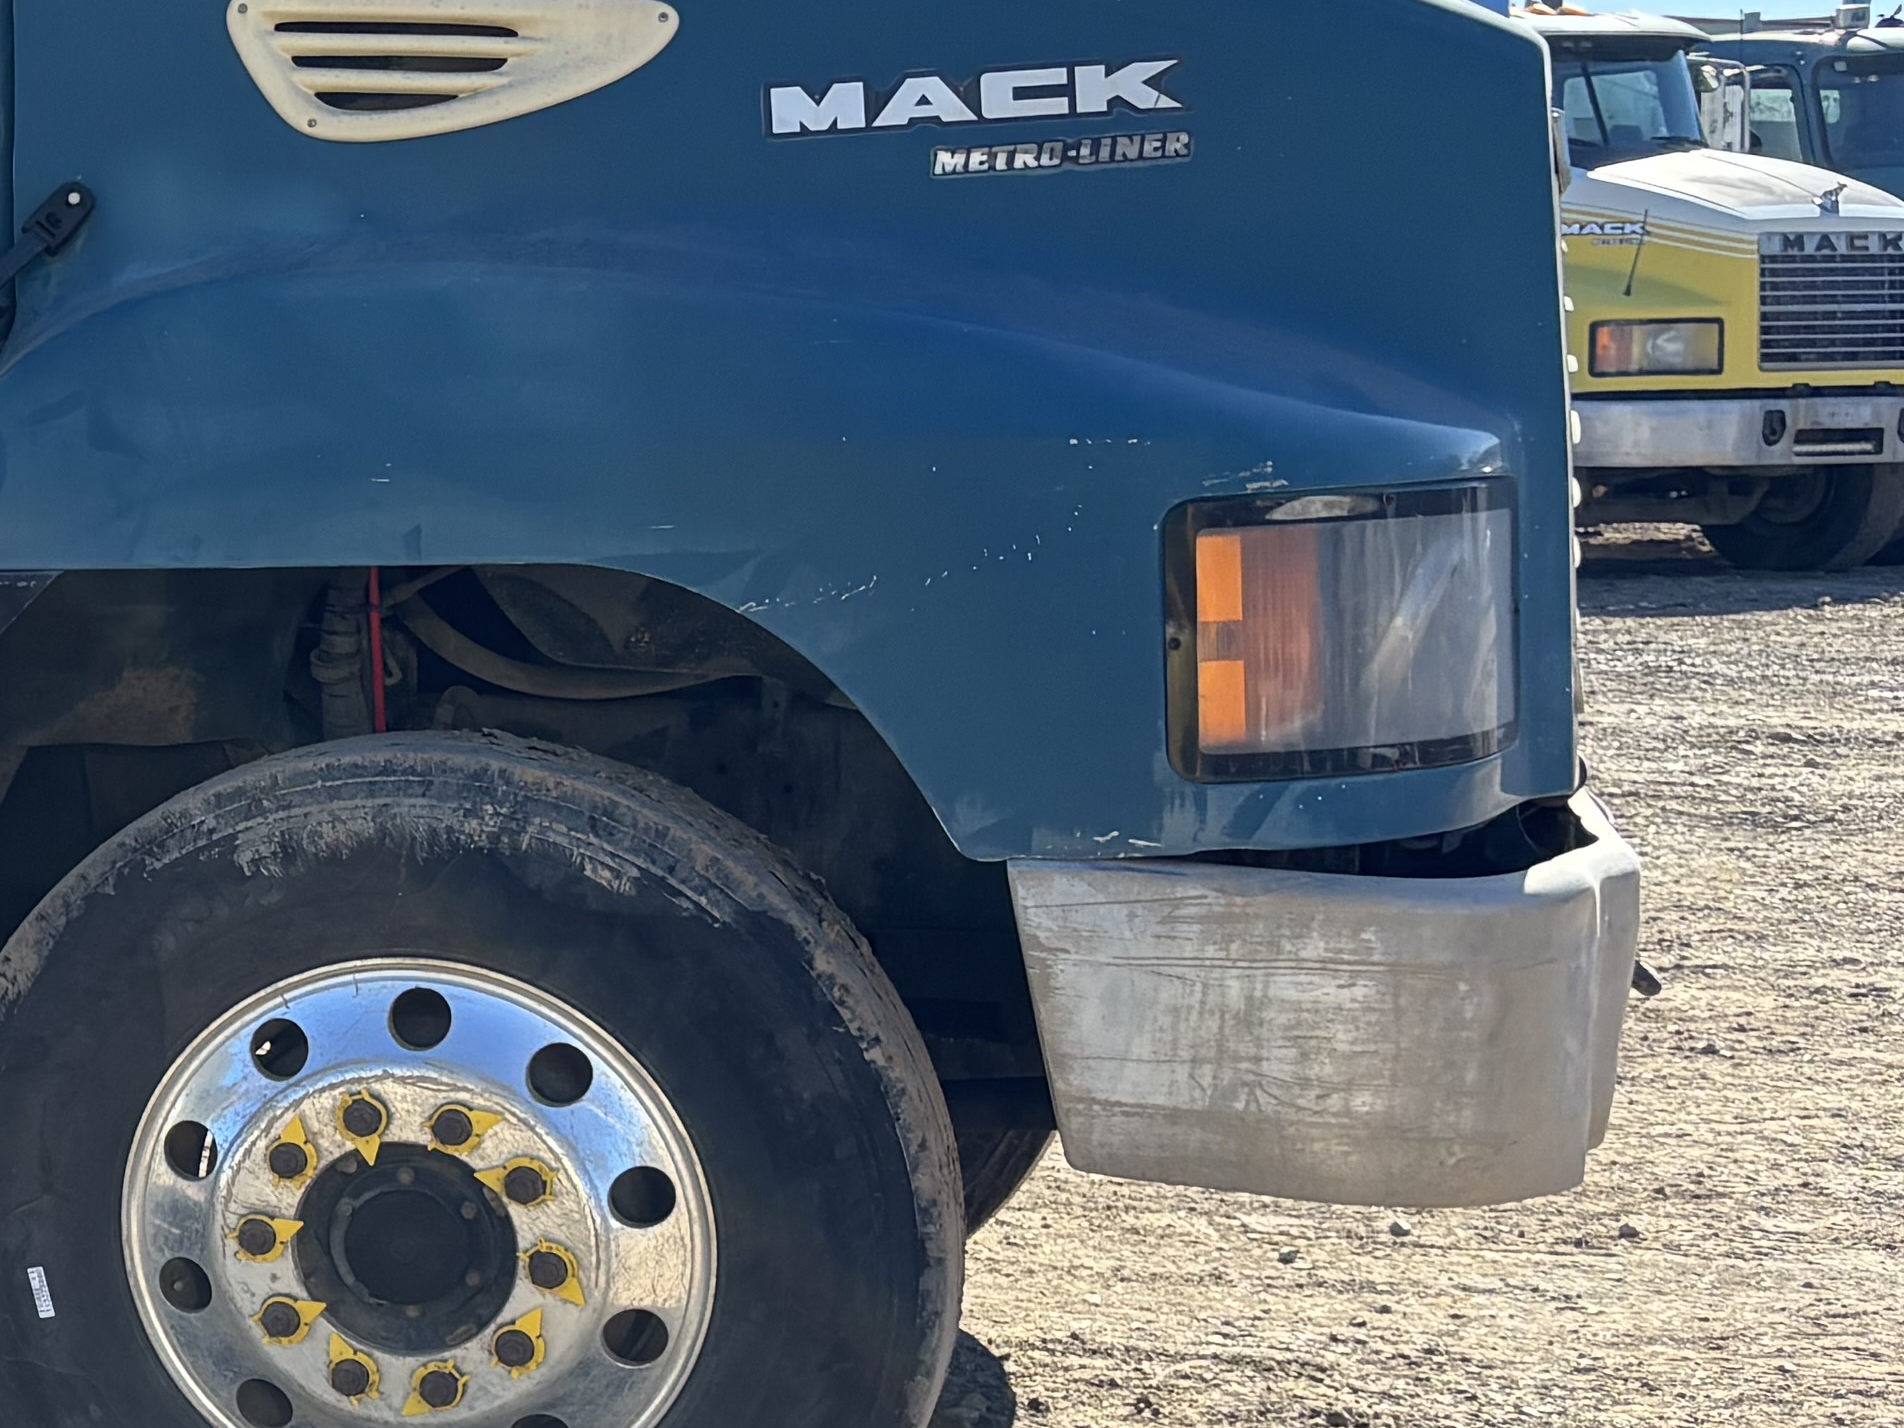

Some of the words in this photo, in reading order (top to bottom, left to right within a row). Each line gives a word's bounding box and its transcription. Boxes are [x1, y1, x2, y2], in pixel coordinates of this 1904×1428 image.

[770, 59, 1183, 134] MACK
[933, 132, 1190, 176] METRO-LINER
[1781, 233, 1903, 252] MACK
